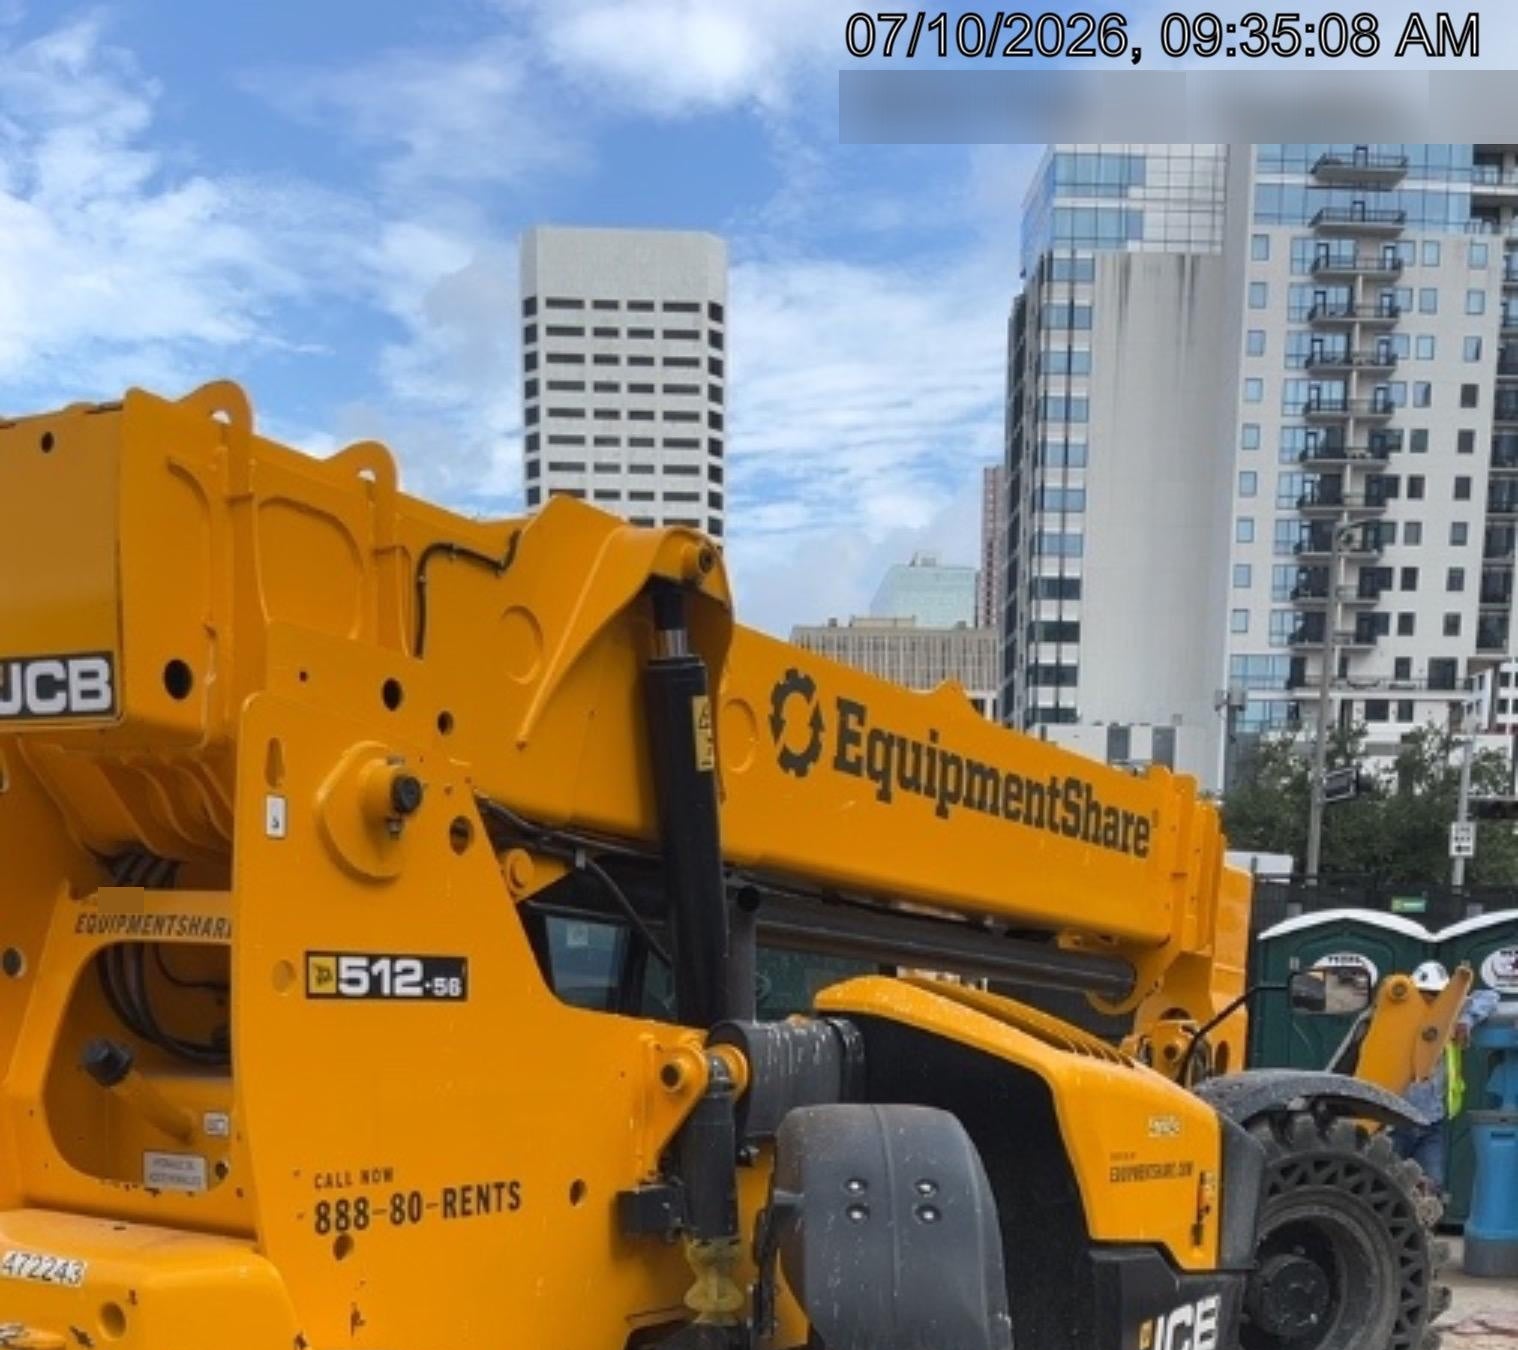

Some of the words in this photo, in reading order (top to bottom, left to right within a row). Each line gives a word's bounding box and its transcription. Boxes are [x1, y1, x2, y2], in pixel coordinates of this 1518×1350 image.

[834, 696, 1150, 858] EquipmentShare
[314, 1172, 352, 1189] CALL
[360, 1167, 394, 1185] NOW
[314, 1180, 522, 1236] 888-80-RENTS
